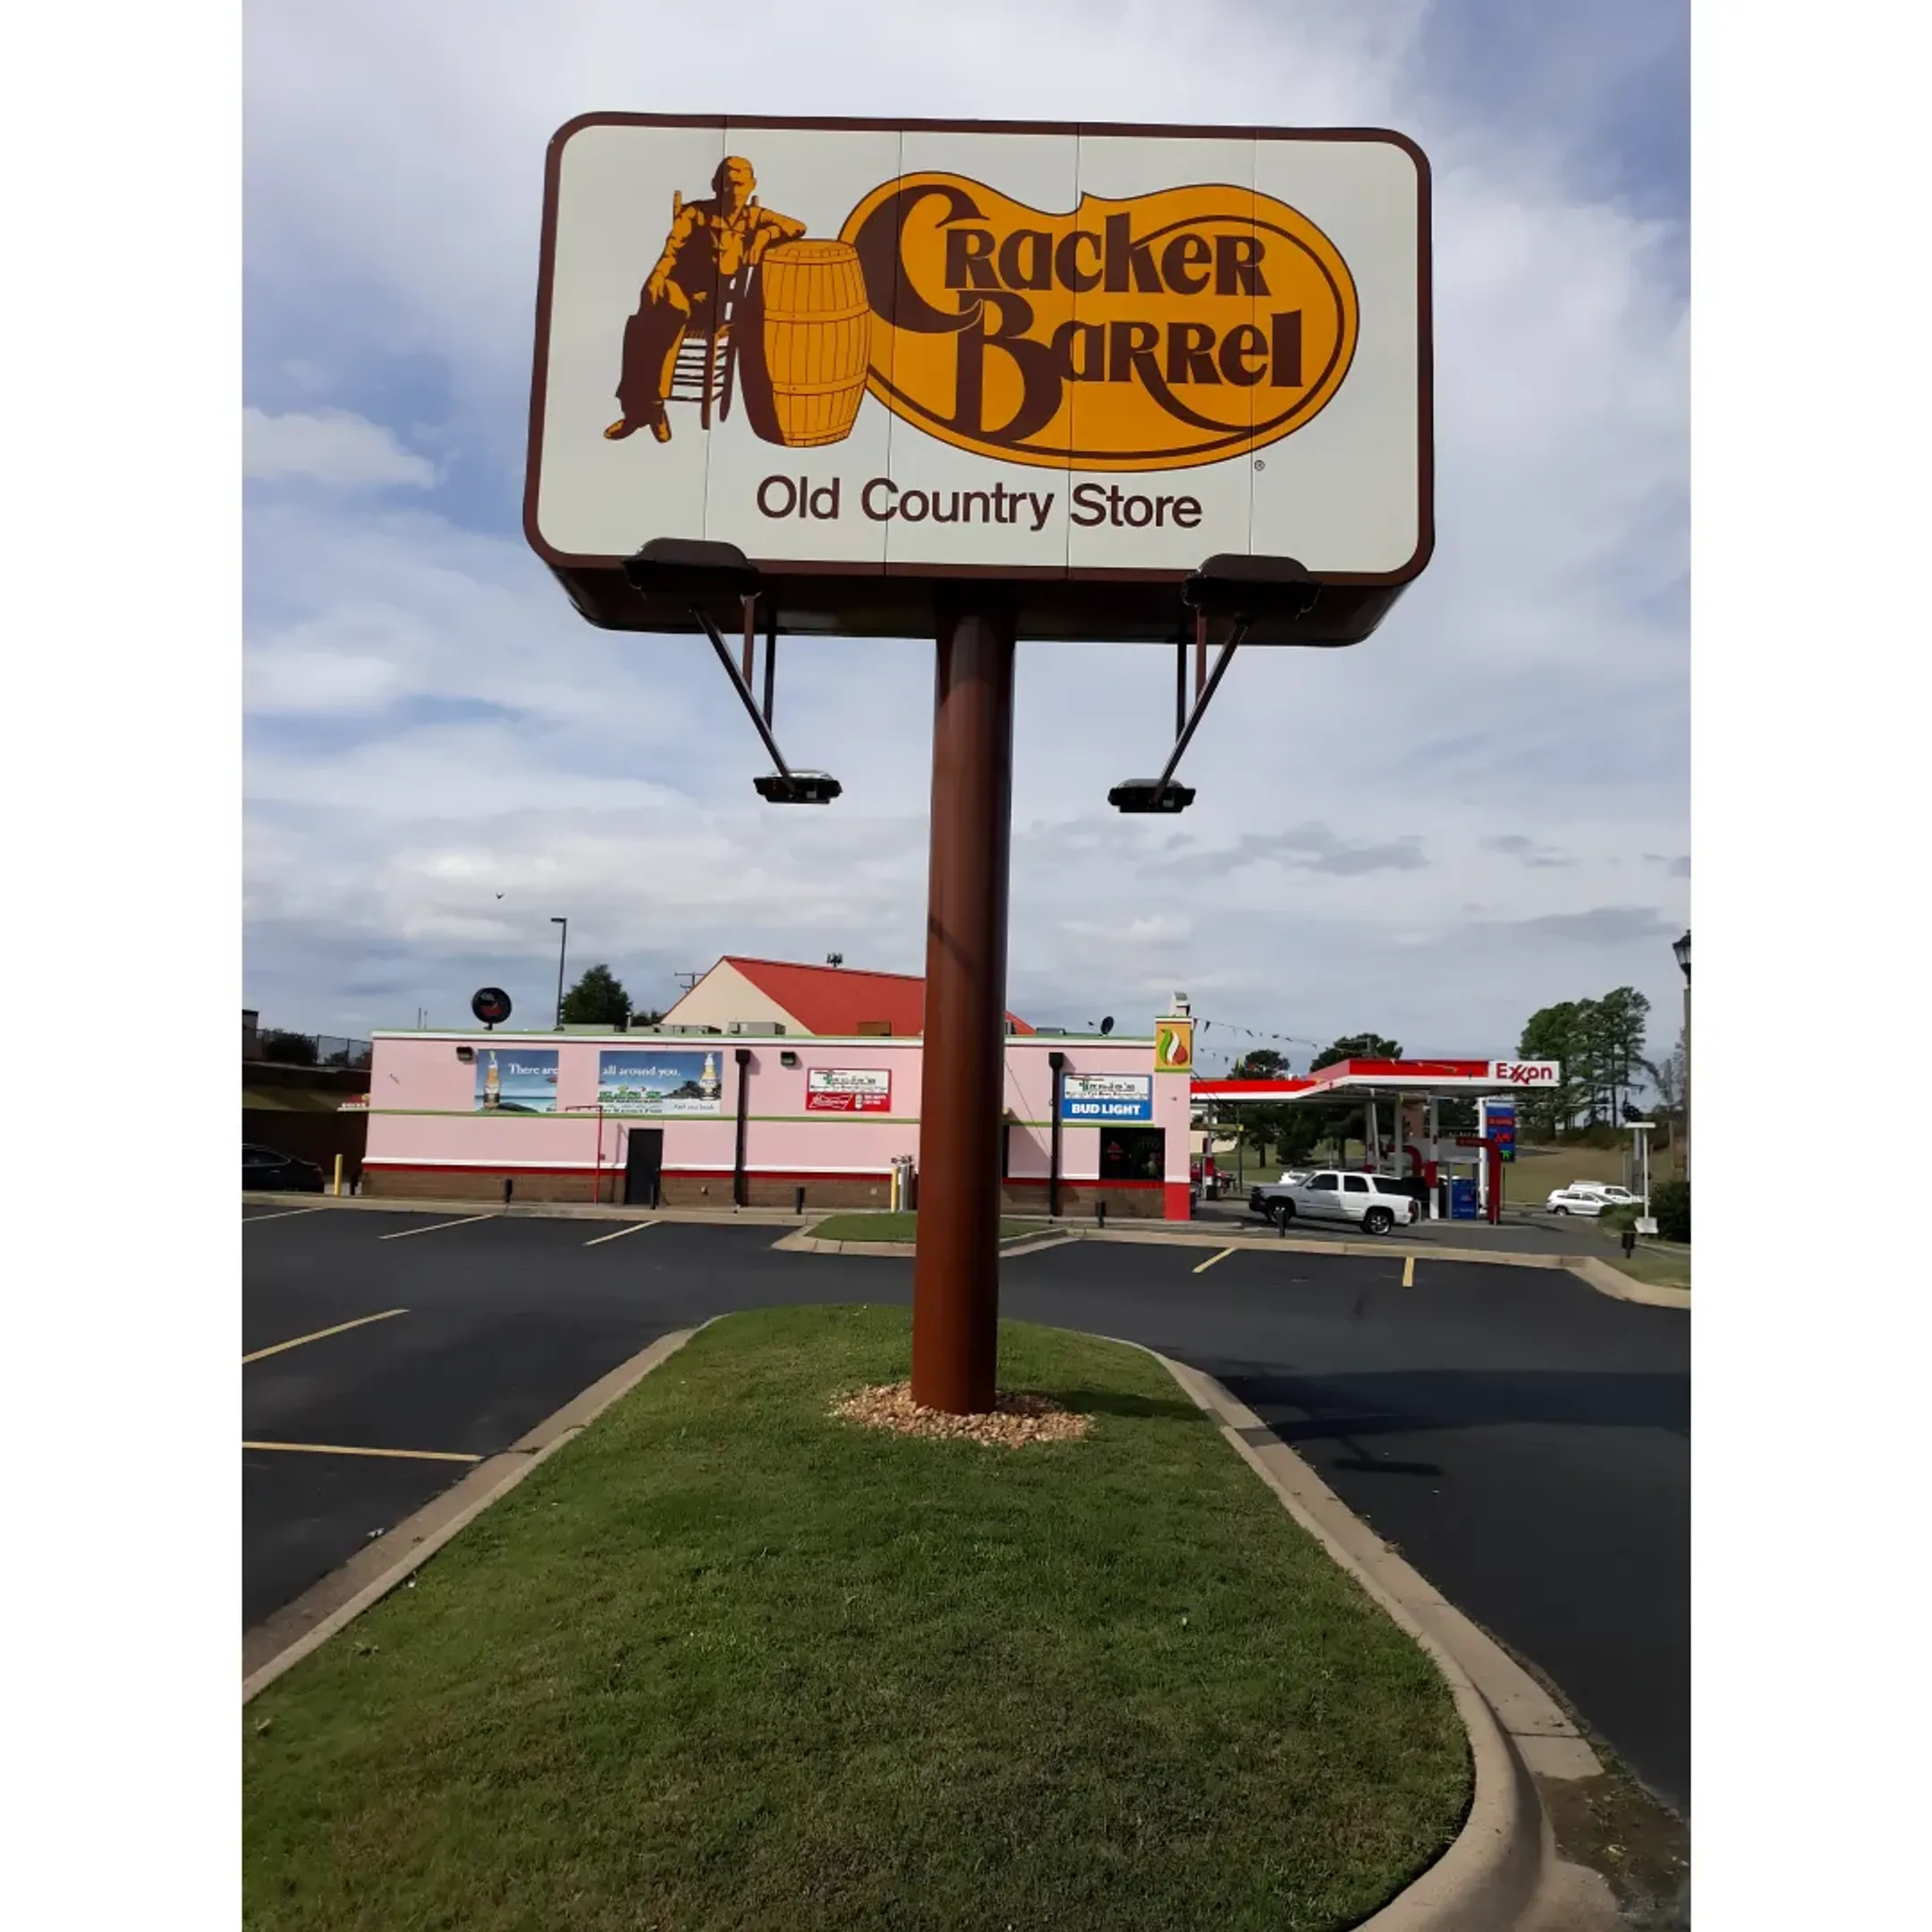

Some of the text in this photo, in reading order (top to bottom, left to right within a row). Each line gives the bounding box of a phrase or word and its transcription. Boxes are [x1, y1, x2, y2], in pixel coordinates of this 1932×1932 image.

[953, 289, 1305, 445] Barrel
[756, 475, 1203, 531] Old Country Store
[508, 1062, 558, 1075] There are
[601, 1064, 681, 1079] all around you.
[1496, 1062, 1553, 1084] Exxon
[1072, 1103, 1141, 1115] BUD LIGHT
